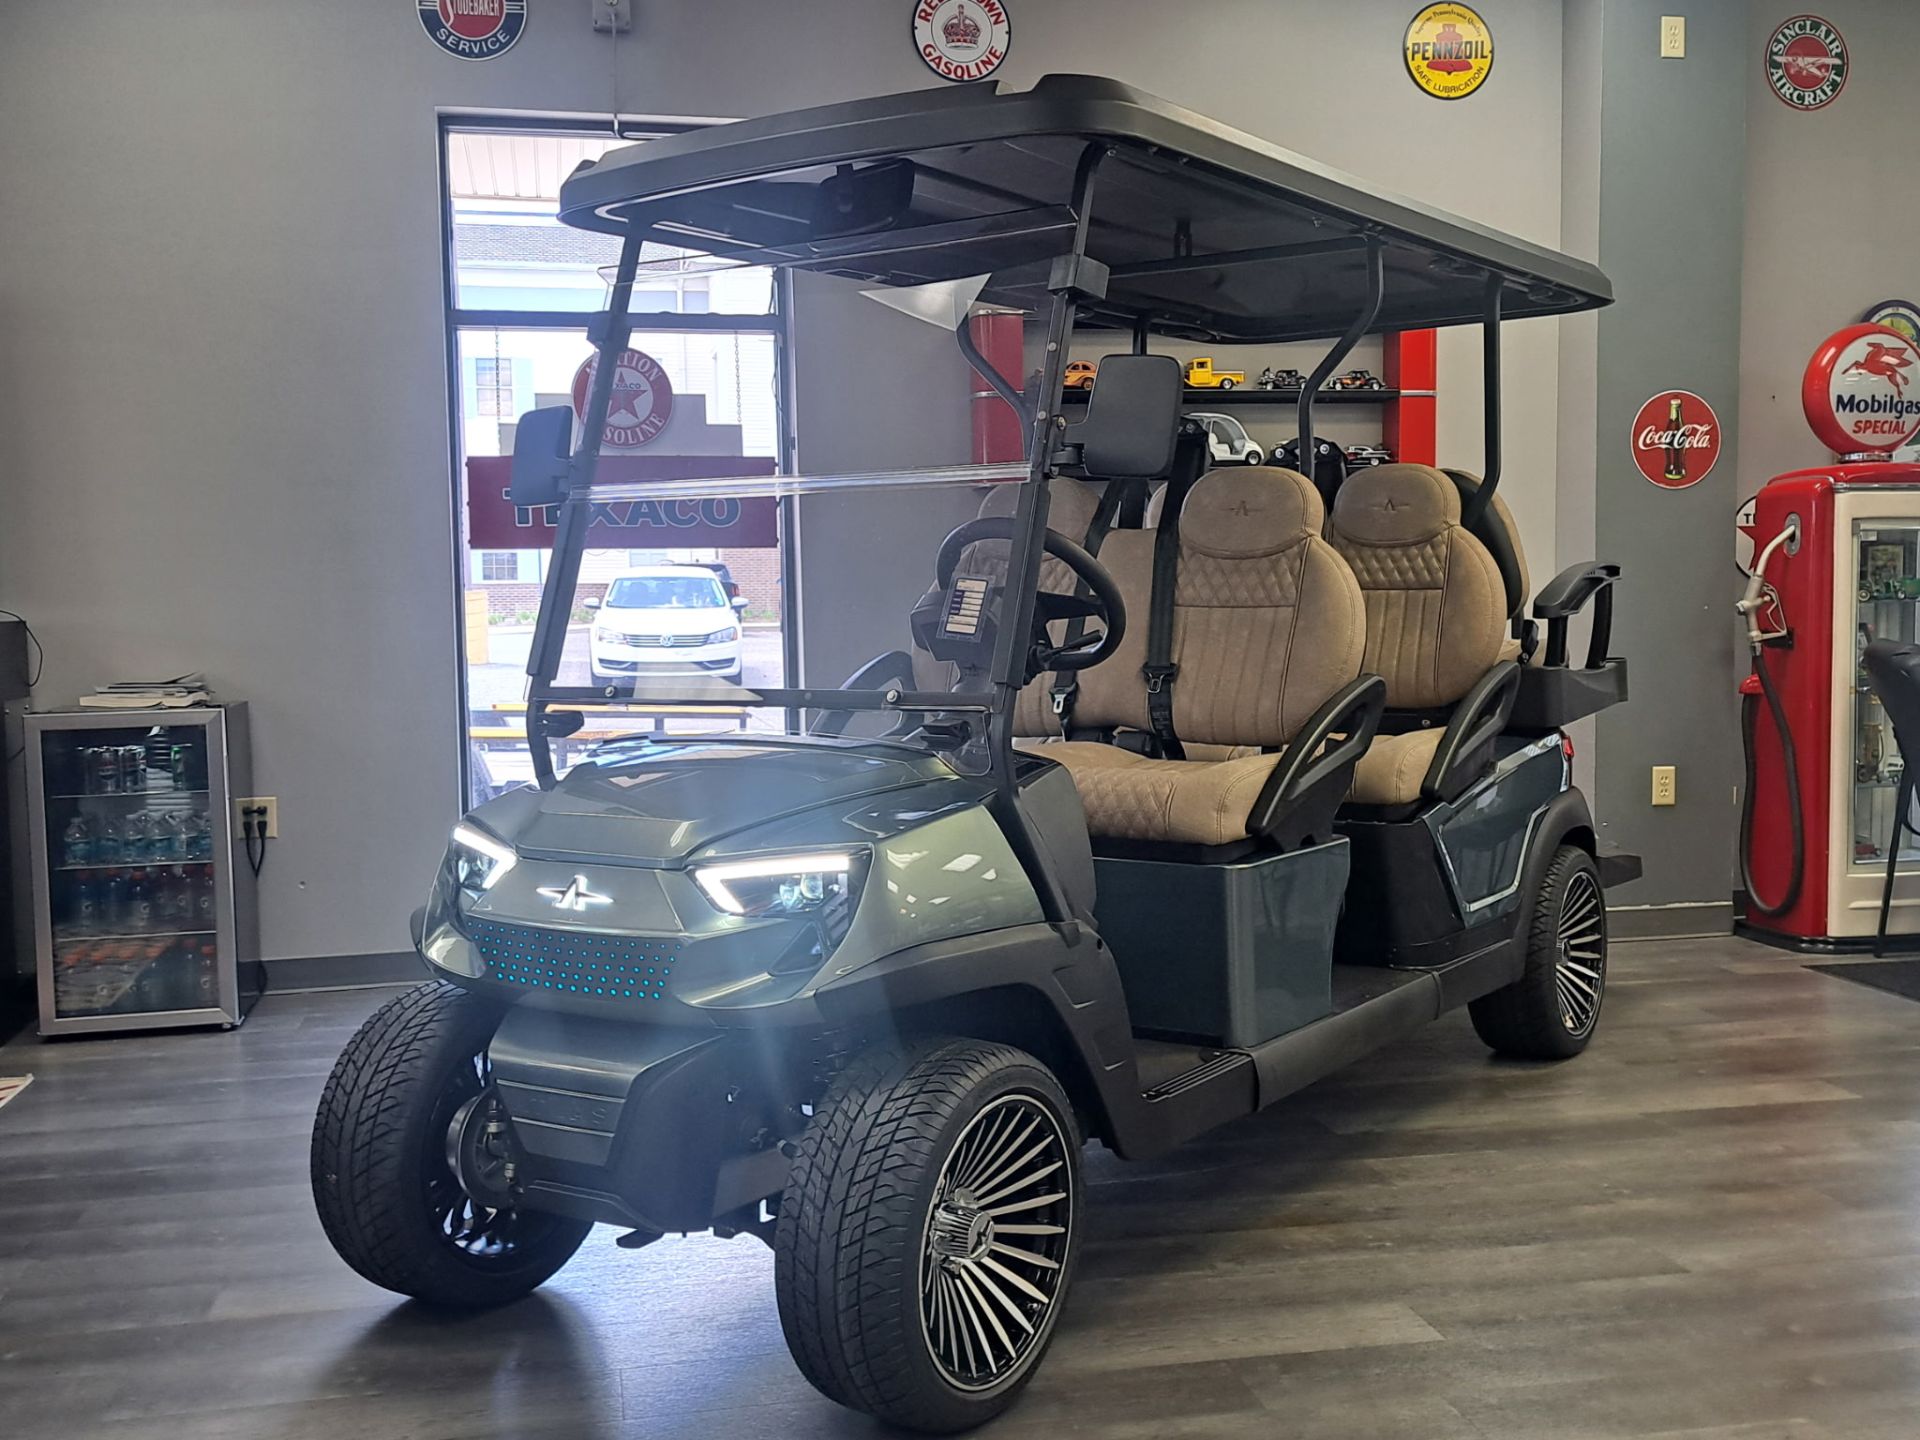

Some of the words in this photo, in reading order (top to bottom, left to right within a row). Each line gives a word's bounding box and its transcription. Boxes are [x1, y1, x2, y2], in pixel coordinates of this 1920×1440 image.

[436, 28, 510, 54] SERVICE
[1411, 40, 1489, 62] PENNZOIL
[1771, 20, 1842, 56] SINCLAIR
[922, 43, 1003, 79] GASOLINE
[1414, 64, 1432, 86] SAFE
[1433, 65, 1485, 94] LUBRICATION
[1770, 68, 1842, 105] AIRCRAFT
[1835, 393, 1920, 420] Mobilgas
[602, 412, 666, 445] SOLINE
[1852, 419, 1906, 435] SPECIAL
